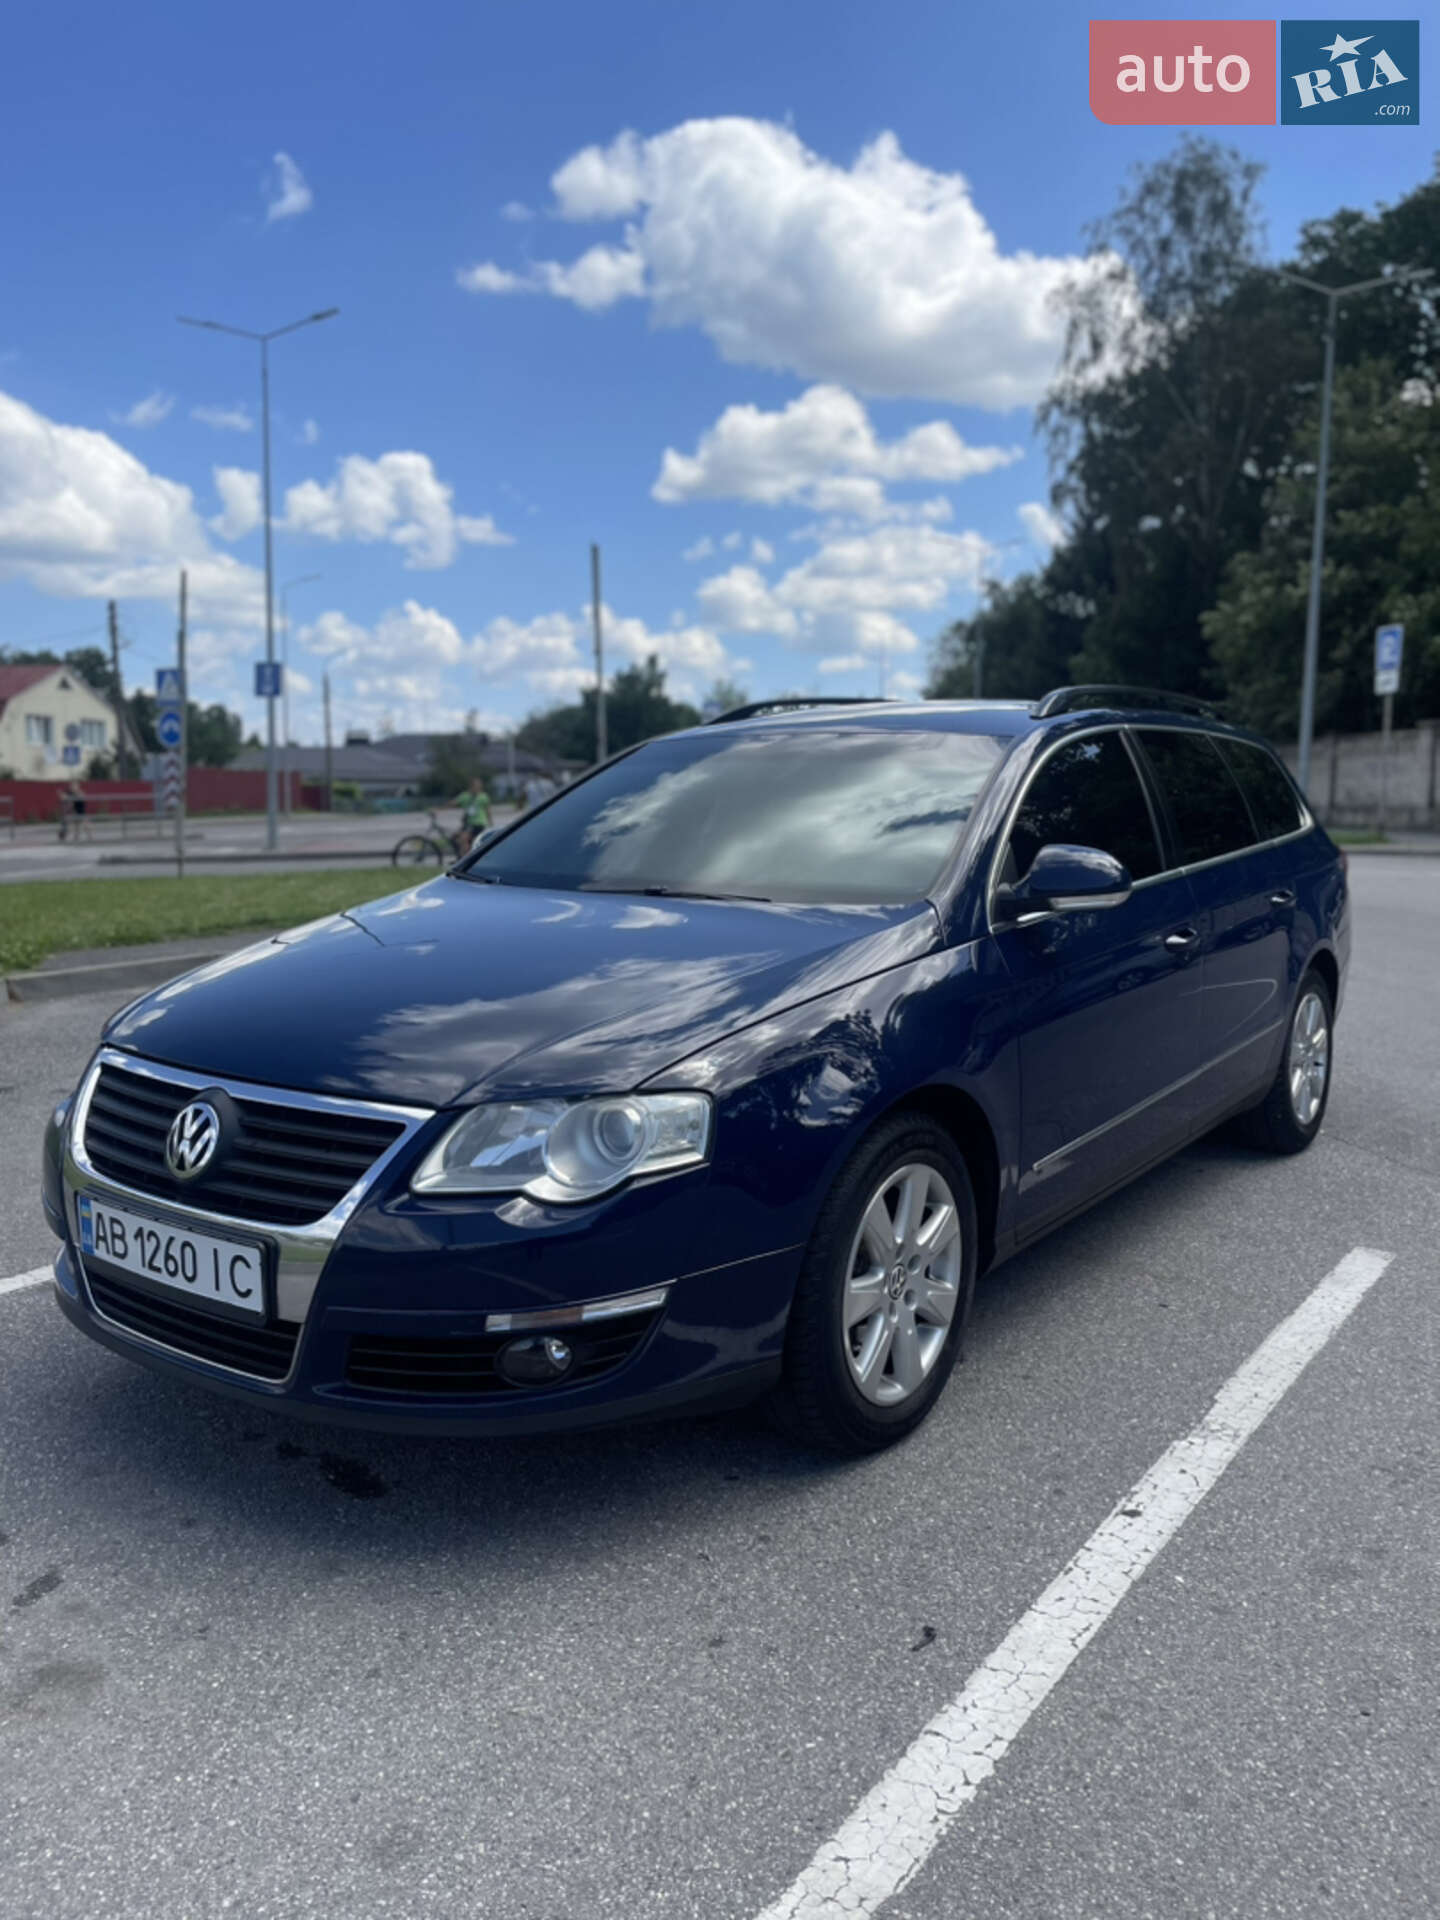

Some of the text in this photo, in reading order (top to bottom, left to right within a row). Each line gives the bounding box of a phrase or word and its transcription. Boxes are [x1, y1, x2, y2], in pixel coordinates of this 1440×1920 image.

[95, 1211, 253, 1298] AB 1260 IC
